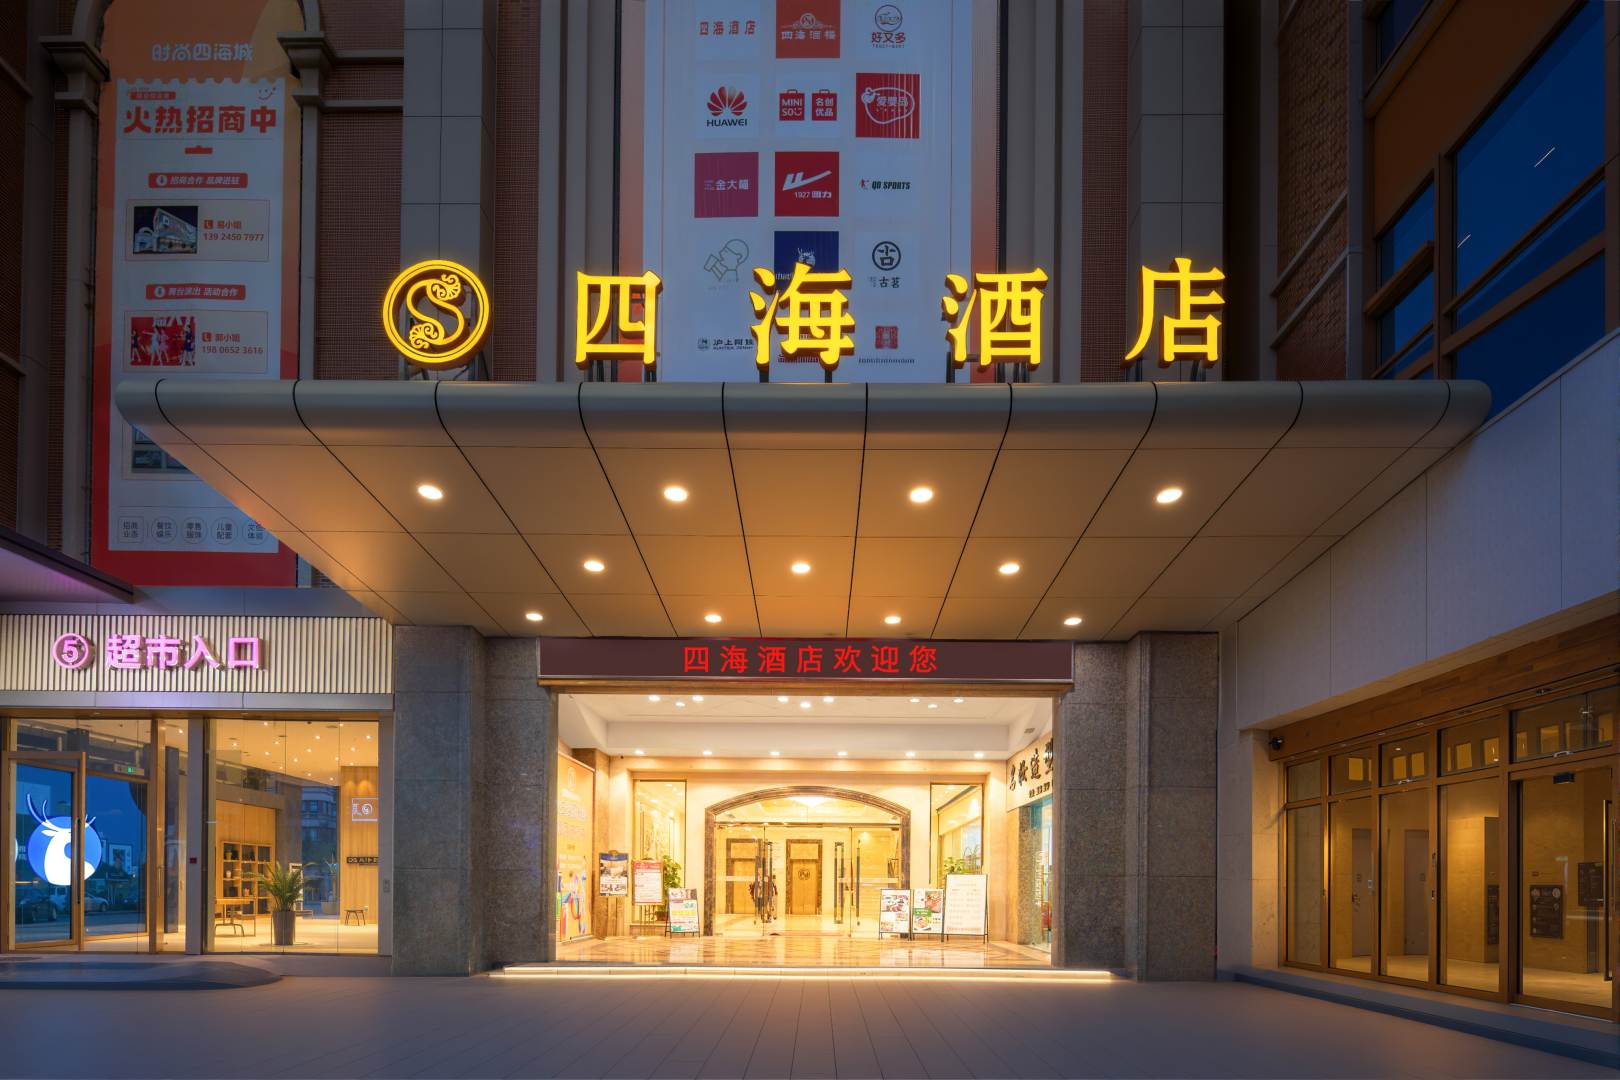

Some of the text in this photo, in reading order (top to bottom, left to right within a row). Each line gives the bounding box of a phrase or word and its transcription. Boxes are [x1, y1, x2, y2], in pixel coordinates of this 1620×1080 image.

[871, 32, 906, 44] 好又多
[151, 43, 254, 62] 时尚四海城
[781, 98, 803, 107] MINI
[123, 105, 277, 134] 火热招商中
[706, 118, 748, 127] HUAWEI
[883, 181, 911, 190] SPORTS
[794, 191, 832, 199] 1927 回力
[203, 233, 219, 241] 139
[221, 233, 242, 241] 2450
[575, 257, 1226, 368] 四海酒店
[202, 346, 217, 354] 198
[106, 633, 263, 670] 超市入口
[683, 645, 938, 673] 四海酒店欢迎您
